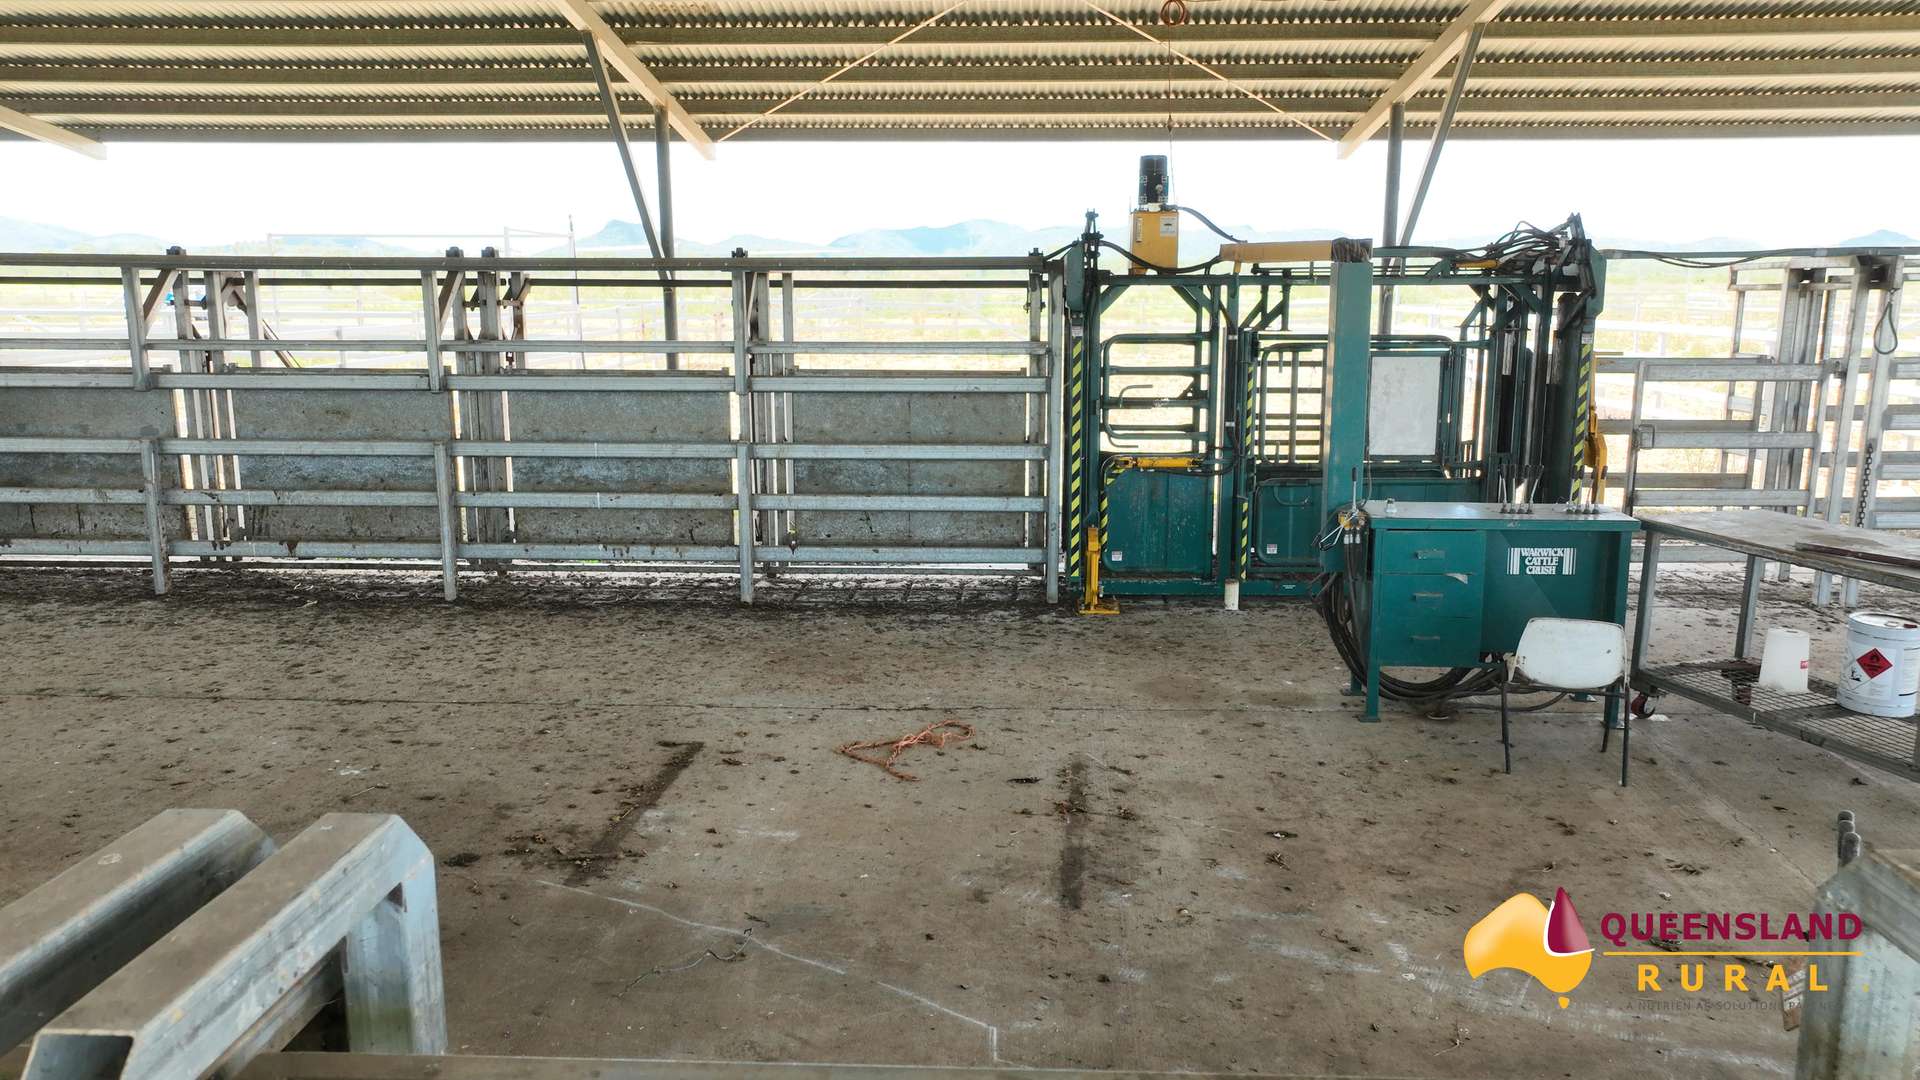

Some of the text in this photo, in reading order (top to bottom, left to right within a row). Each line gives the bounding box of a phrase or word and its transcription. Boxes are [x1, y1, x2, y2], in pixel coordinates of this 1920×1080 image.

[1521, 547, 1564, 557] WARWICK
[1525, 557, 1558, 566] CATTLE
[1526, 566, 1556, 575] CRUSH
